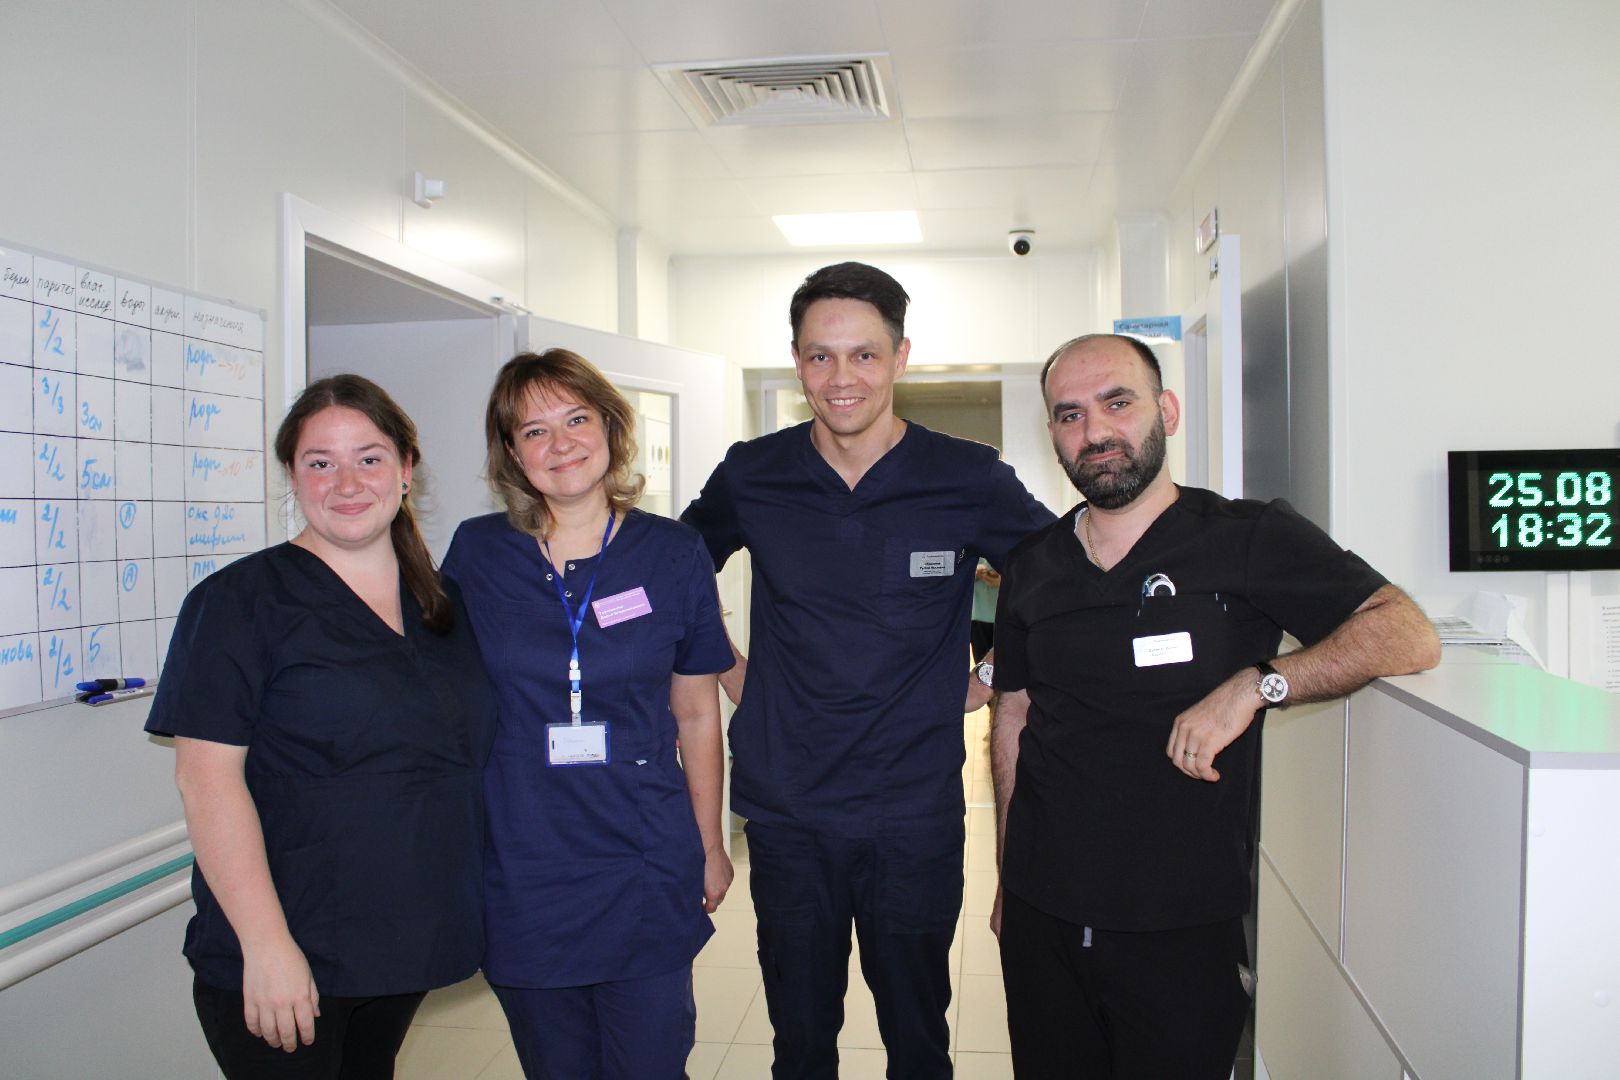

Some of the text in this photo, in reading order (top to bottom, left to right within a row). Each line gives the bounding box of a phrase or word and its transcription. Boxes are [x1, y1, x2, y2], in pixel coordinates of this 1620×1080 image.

[1489, 472, 1612, 507] 25.08
[1491, 513, 1612, 547] 18:32
[0, 639, 33, 664] нова
